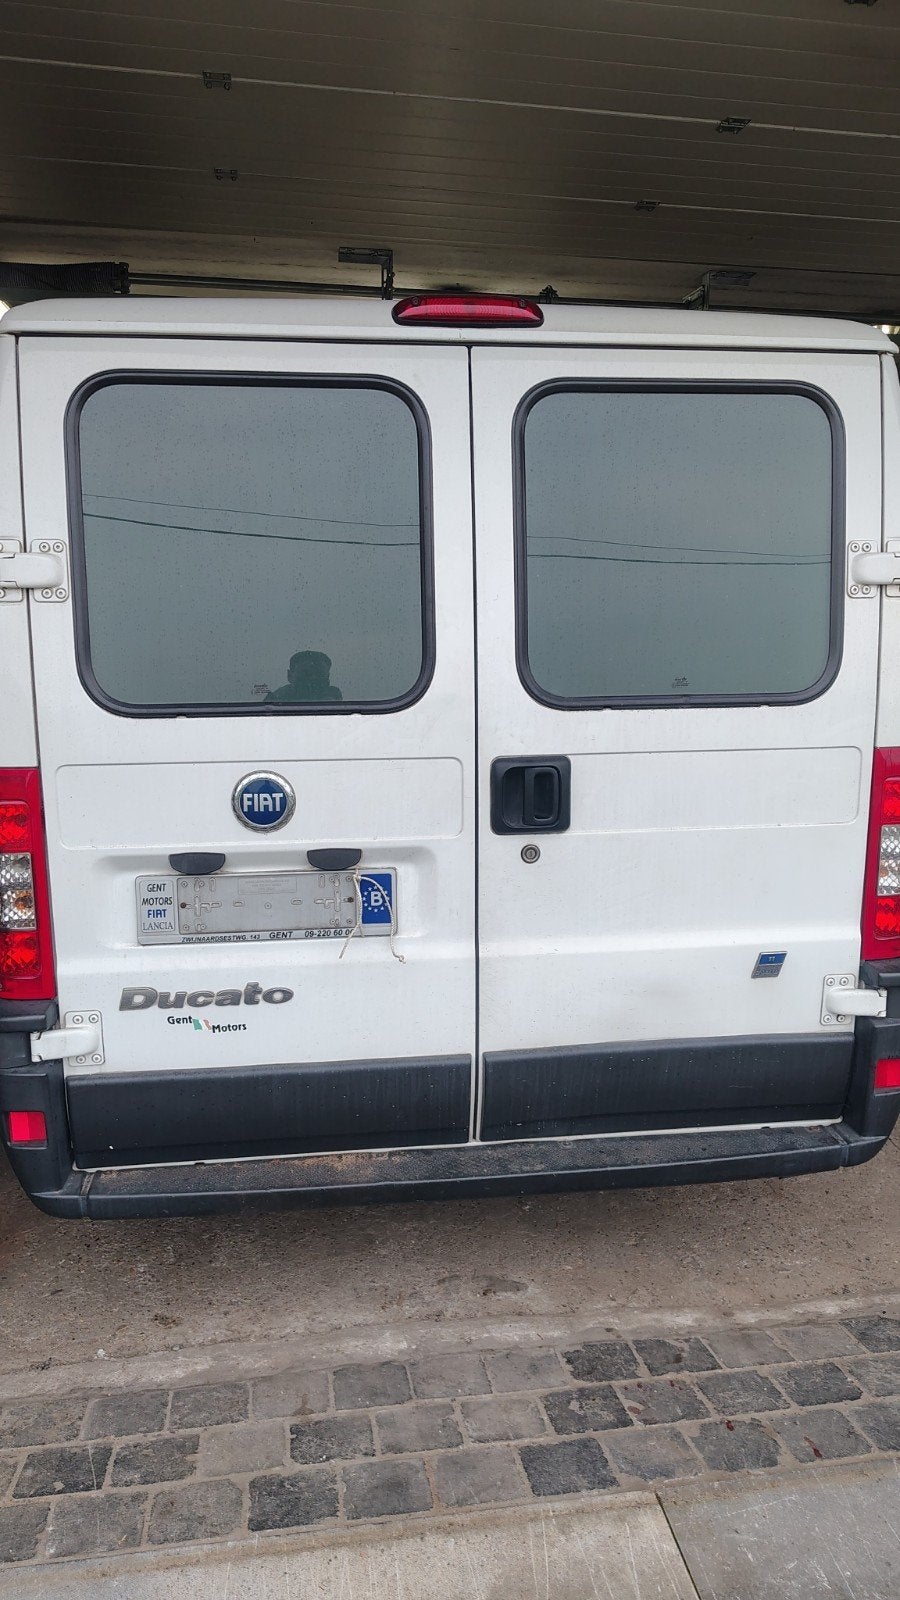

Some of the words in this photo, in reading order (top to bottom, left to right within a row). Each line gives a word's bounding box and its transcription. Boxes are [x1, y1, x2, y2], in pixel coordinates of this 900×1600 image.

[243, 792, 284, 812] FIAT
[147, 883, 167, 893] GENT
[142, 896, 173, 906] MOTORS
[370, 891, 383, 907] B
[147, 908, 167, 919] FIAT
[142, 921, 174, 931] LANCIA
[269, 931, 293, 939] GENT
[304, 930, 331, 938] 09-220
[119, 981, 294, 1011] Ducato
[167, 1015, 193, 1025] Gent
[211, 1023, 247, 1034] Motors
